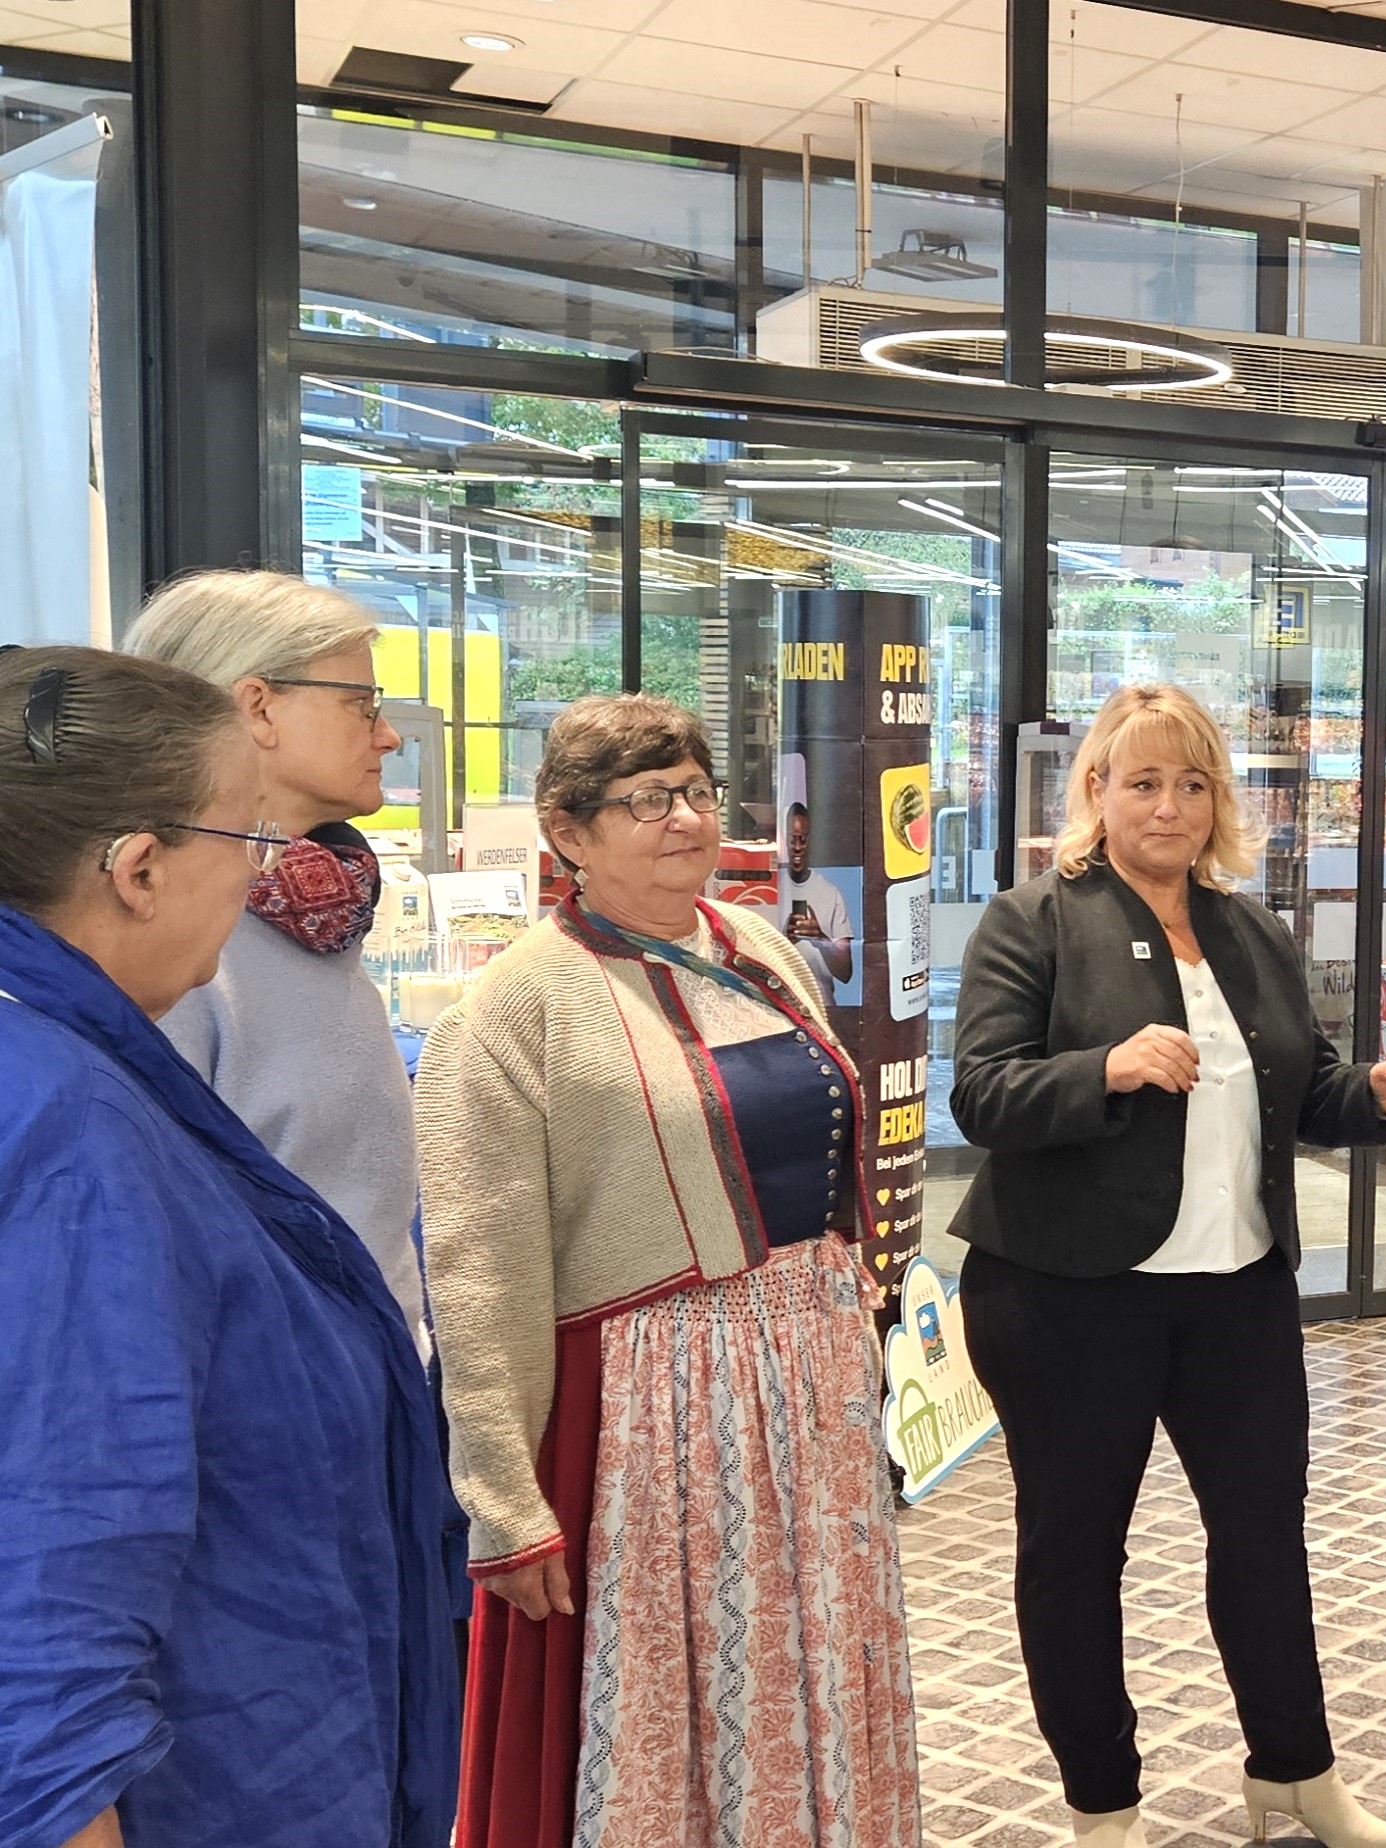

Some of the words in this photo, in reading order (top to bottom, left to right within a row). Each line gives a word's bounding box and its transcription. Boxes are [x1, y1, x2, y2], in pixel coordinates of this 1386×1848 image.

[880, 644, 916, 682] APP
[919, 646, 930, 683] R
[880, 690, 895, 724] &
[898, 693, 931, 724] ABSA
[477, 848, 527, 865] WERDENFELSER
[880, 1060, 913, 1101] HOL
[915, 1054, 928, 1095] DI
[878, 1101, 924, 1146] EDEKA
[876, 1157, 891, 1171] Bei
[912, 1285, 934, 1306] UNSER
[928, 1363, 950, 1383] LAND
[904, 1414, 941, 1476] FAIR
